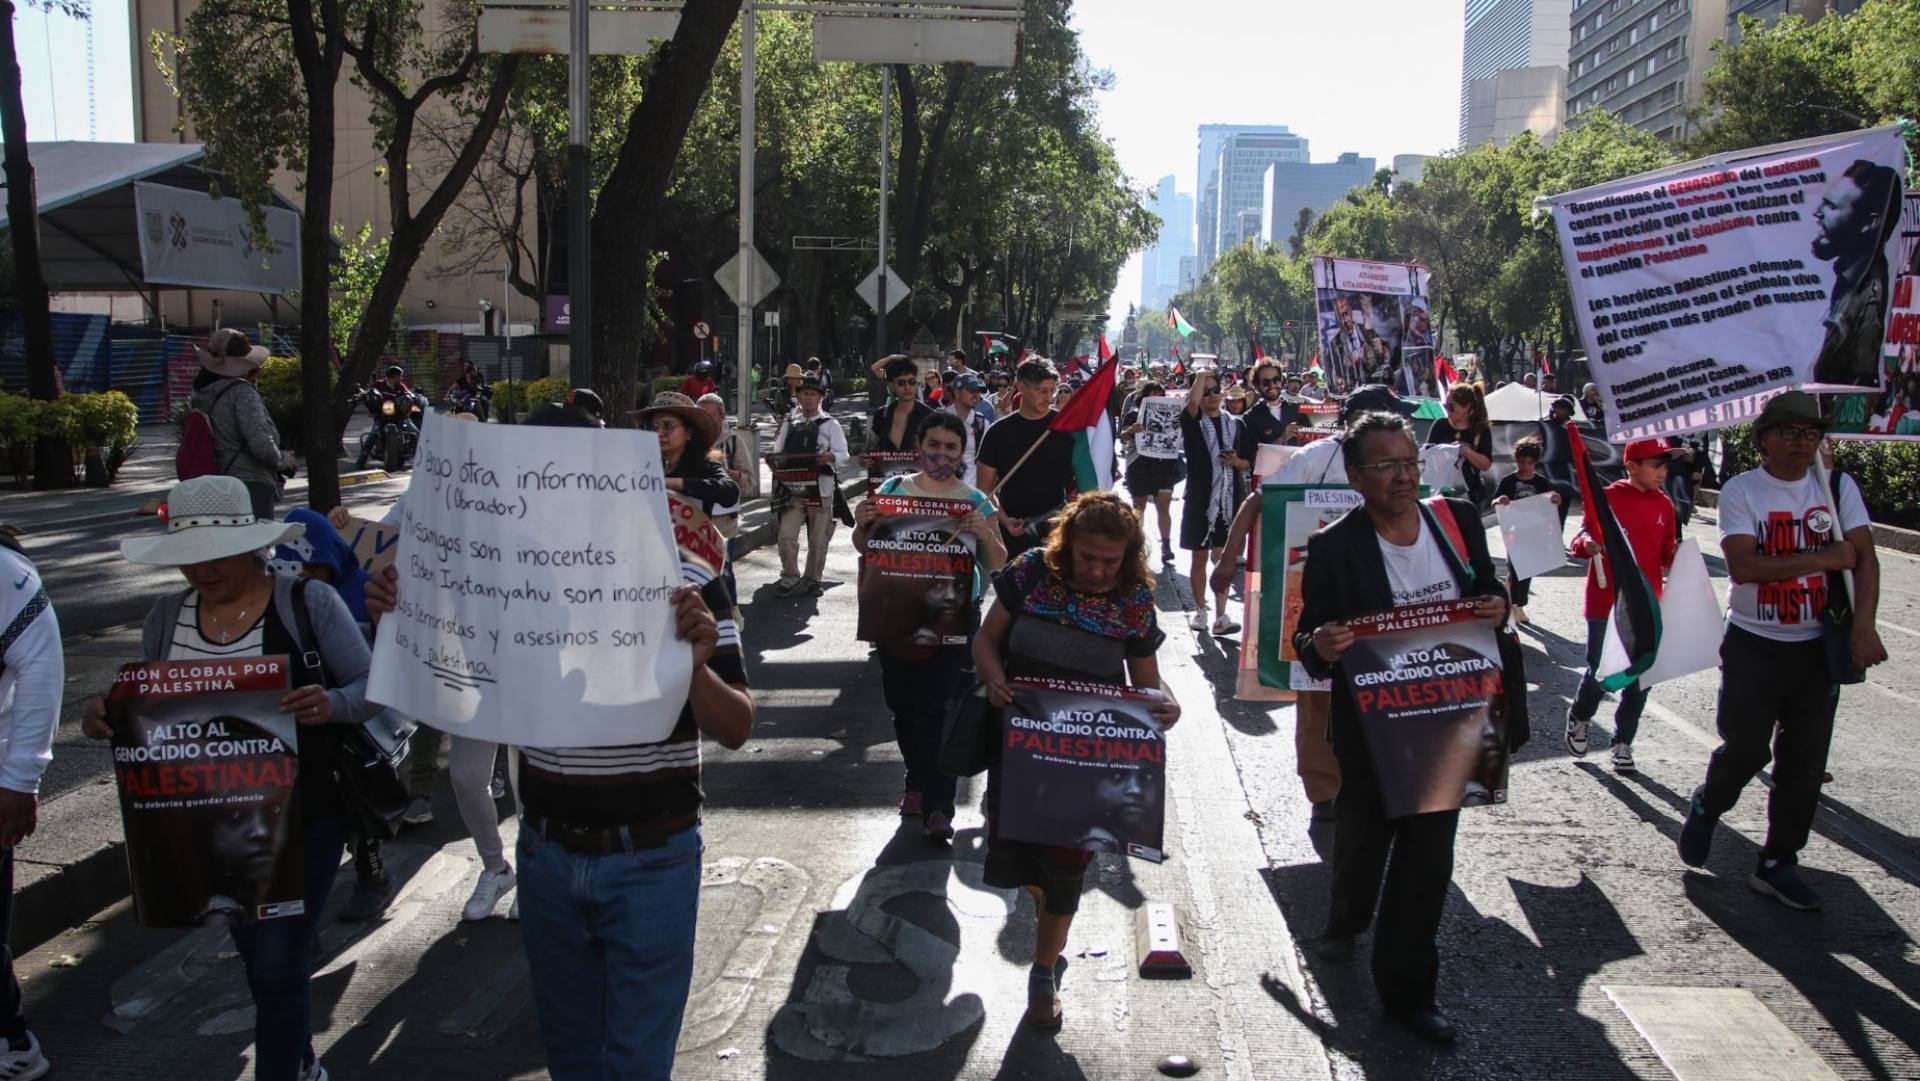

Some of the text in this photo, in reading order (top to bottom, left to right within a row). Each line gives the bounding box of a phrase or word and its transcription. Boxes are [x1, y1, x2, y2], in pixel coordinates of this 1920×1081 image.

[1653, 185, 1667, 199] el
[1668, 170, 1738, 196] GENOCIDIO
[1739, 166, 1762, 181] del
[1763, 157, 1820, 177] nazismo
[1568, 212, 1612, 232] contra
[1613, 207, 1628, 222] el
[1629, 199, 1676, 219] pueblo
[1727, 187, 1736, 199] y
[1737, 184, 1763, 196] hoy
[1764, 177, 1799, 191] nada
[1799, 171, 1827, 185] hay
[1572, 190, 1805, 247] más parecido que el que realizan el
[1665, 232, 1676, 246] y
[1676, 227, 1691, 243] el
[1691, 214, 1755, 239] sionismo
[1755, 209, 1801, 226] contra
[1580, 264, 1594, 279] el
[1595, 256, 1643, 277] pueblo
[1588, 297, 1612, 312] Los
[1673, 265, 1749, 295] palestinos
[1748, 258, 1805, 275] ejemplo
[1592, 272, 1821, 329] de patriotismo son el símbolo vivo
[1596, 288, 1827, 346] del crimen más grande de nuestra
[1610, 371, 1666, 396] Fragmento
[1616, 384, 1680, 409] Comandante
[1680, 374, 1708, 391] Fidel
[1619, 402, 1667, 423] Naciones
[1707, 385, 1722, 399] 12
[1721, 375, 1766, 395] octubre
[1765, 365, 1794, 382] 1979
[459, 448, 500, 489] otra
[517, 460, 665, 494] información
[876, 497, 973, 511] CCIÓN GLOBAL POR
[1308, 491, 1361, 505] PALESTINA
[896, 506, 949, 518] PALESTINA
[867, 539, 969, 556] GENOCIDIO CONTRA
[896, 530, 942, 543] ¡ALTO AL
[470, 541, 501, 562] son
[864, 552, 973, 574] PALESTINA!
[564, 586, 603, 605] son
[612, 575, 681, 602] inocente
[1346, 610, 1395, 627] ACCIÓN
[1399, 603, 1452, 619] GLOBAL
[1377, 614, 1450, 633] PALESTINA
[514, 621, 598, 646] asesinos
[611, 628, 646, 647] son
[1389, 648, 1451, 670] ¡ALTO AL
[113, 662, 280, 683] CCIÓN GLOBAL POR
[1354, 665, 1433, 687] GENOCIDIO
[1434, 657, 1494, 678] CONTRA
[139, 679, 236, 695] PALESTINA
[1049, 683, 1123, 698] PALESTINA
[1070, 679, 1122, 690] GLOBAL
[1128, 686, 1151, 695] PO
[1356, 671, 1505, 713] PALESTINA!
[1011, 716, 1158, 741] GENOCIDIO CONTRA
[1052, 709, 1116, 724] ¡ALTO AL
[147, 721, 231, 746] ¡ALTO AL
[114, 737, 285, 763] GENOCIDIO CONTRA
[1007, 729, 1163, 764] PALESTINA!
[186, 796, 225, 809] guardar
[226, 792, 265, 805] silencio
